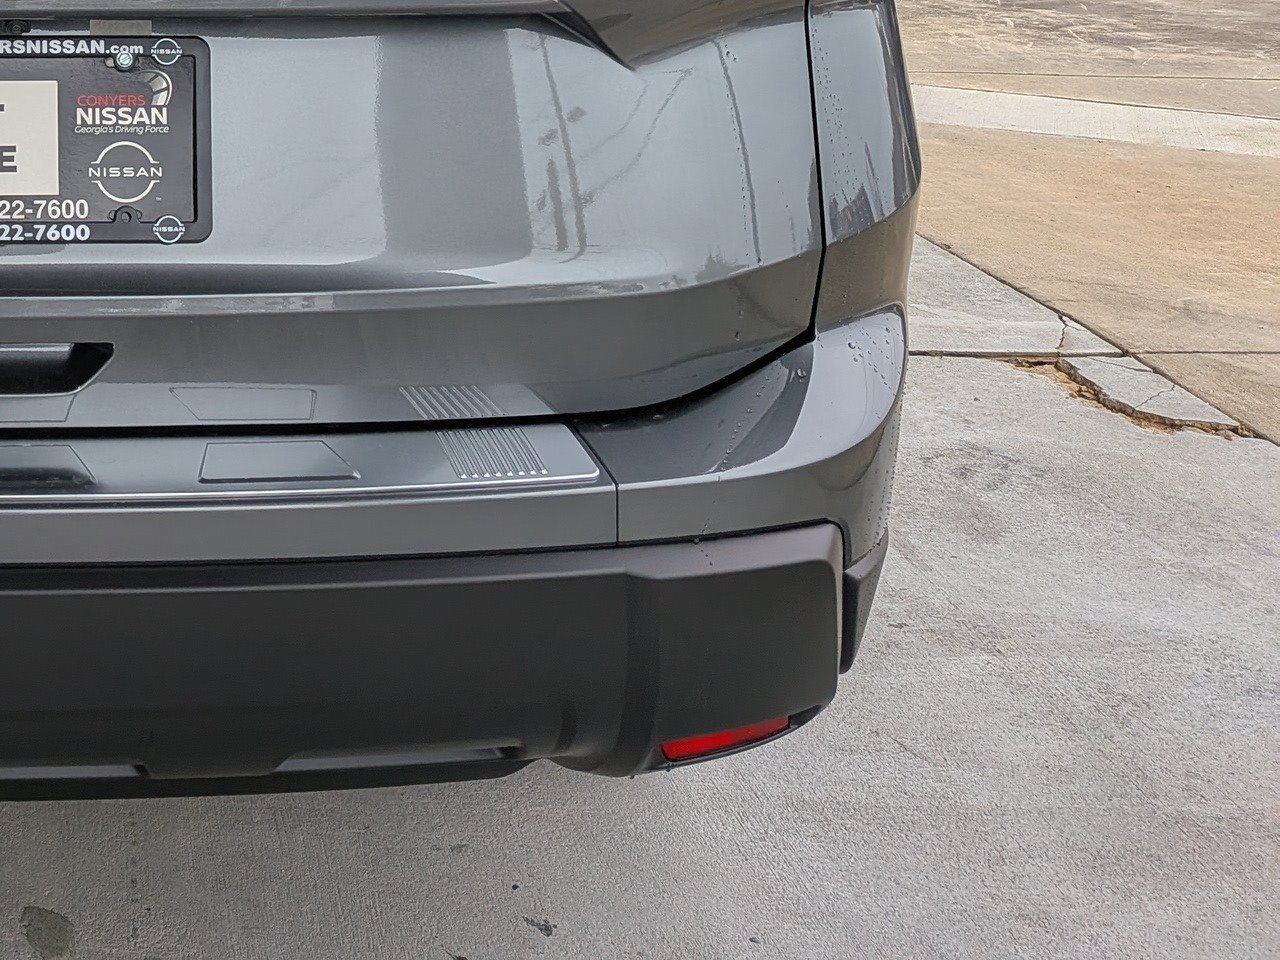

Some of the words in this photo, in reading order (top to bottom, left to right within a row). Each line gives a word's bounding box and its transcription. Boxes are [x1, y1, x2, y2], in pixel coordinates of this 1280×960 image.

[76, 94, 146, 107] CONYERS
[76, 107, 168, 125] NISSAN
[74, 125, 114, 135] Georgia's
[114, 125, 144, 135] Driving
[144, 125, 170, 134] Force
[88, 166, 163, 177] NISSAN
